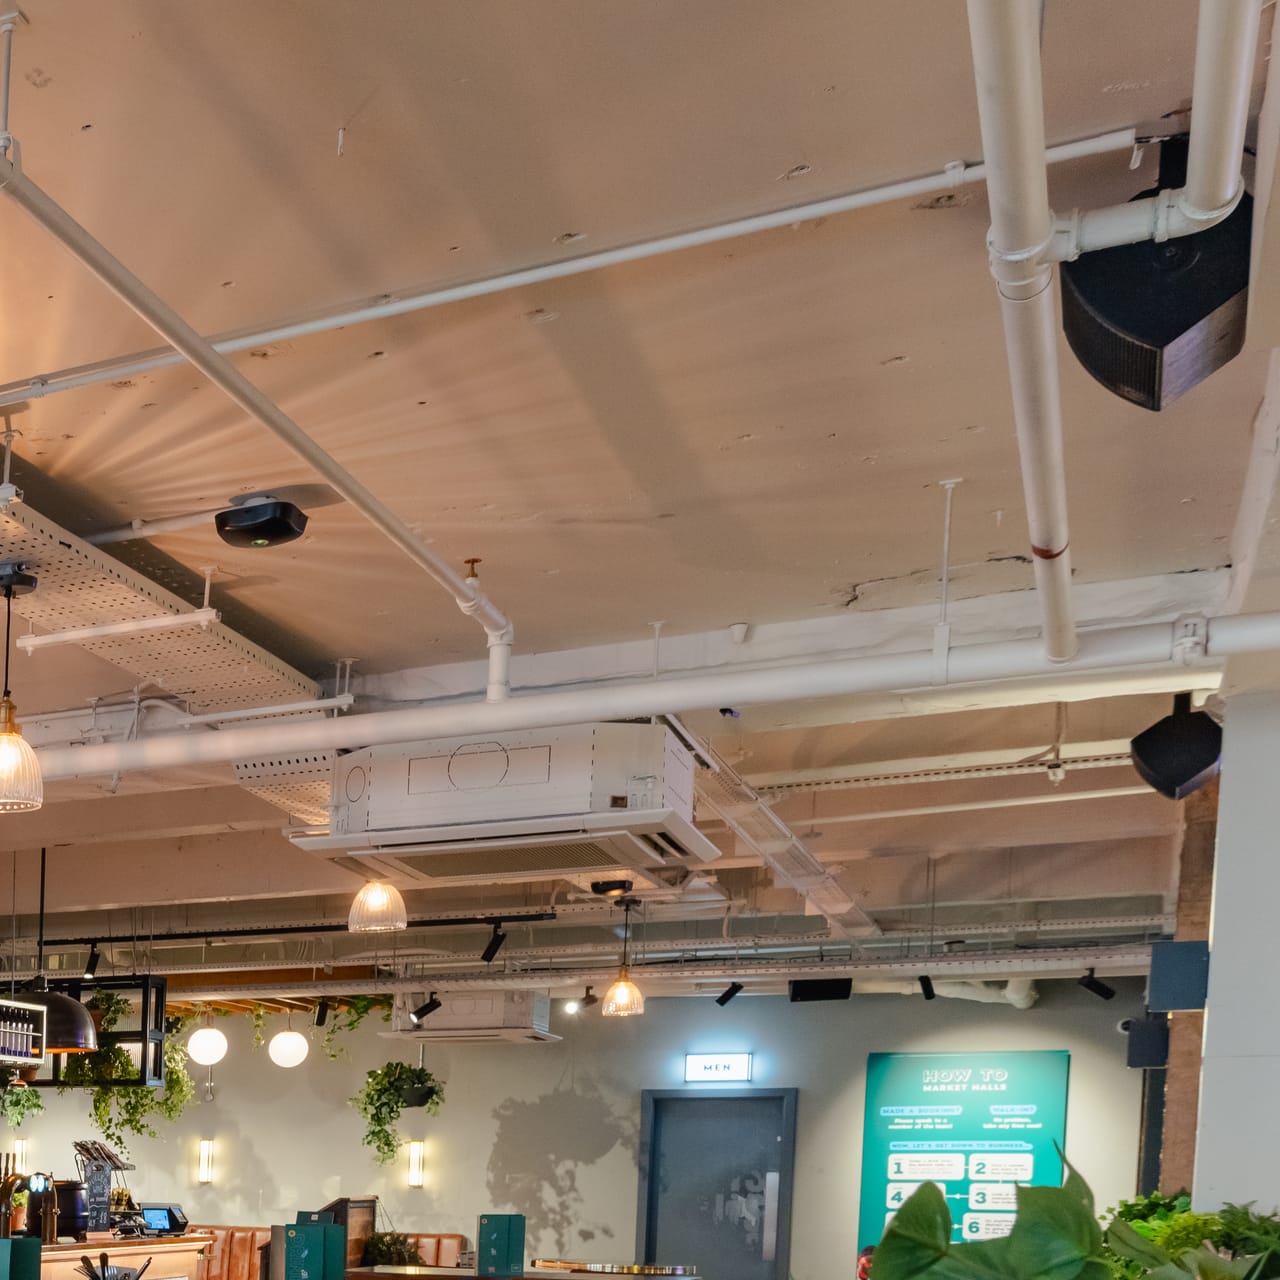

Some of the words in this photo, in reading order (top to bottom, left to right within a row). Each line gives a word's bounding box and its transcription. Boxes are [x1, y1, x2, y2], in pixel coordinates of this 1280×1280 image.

[703, 1064, 731, 1072] MEN
[922, 1068, 972, 1084] HOW
[979, 1067, 1009, 1083] TO
[922, 1084, 968, 1093] MARKET
[971, 1083, 1008, 1092] HALLS
[893, 1162, 904, 1175] 1
[975, 1162, 987, 1175] 2
[891, 1191, 904, 1203] 4
[975, 1192, 988, 1204] 3
[968, 1221, 980, 1233] 6
